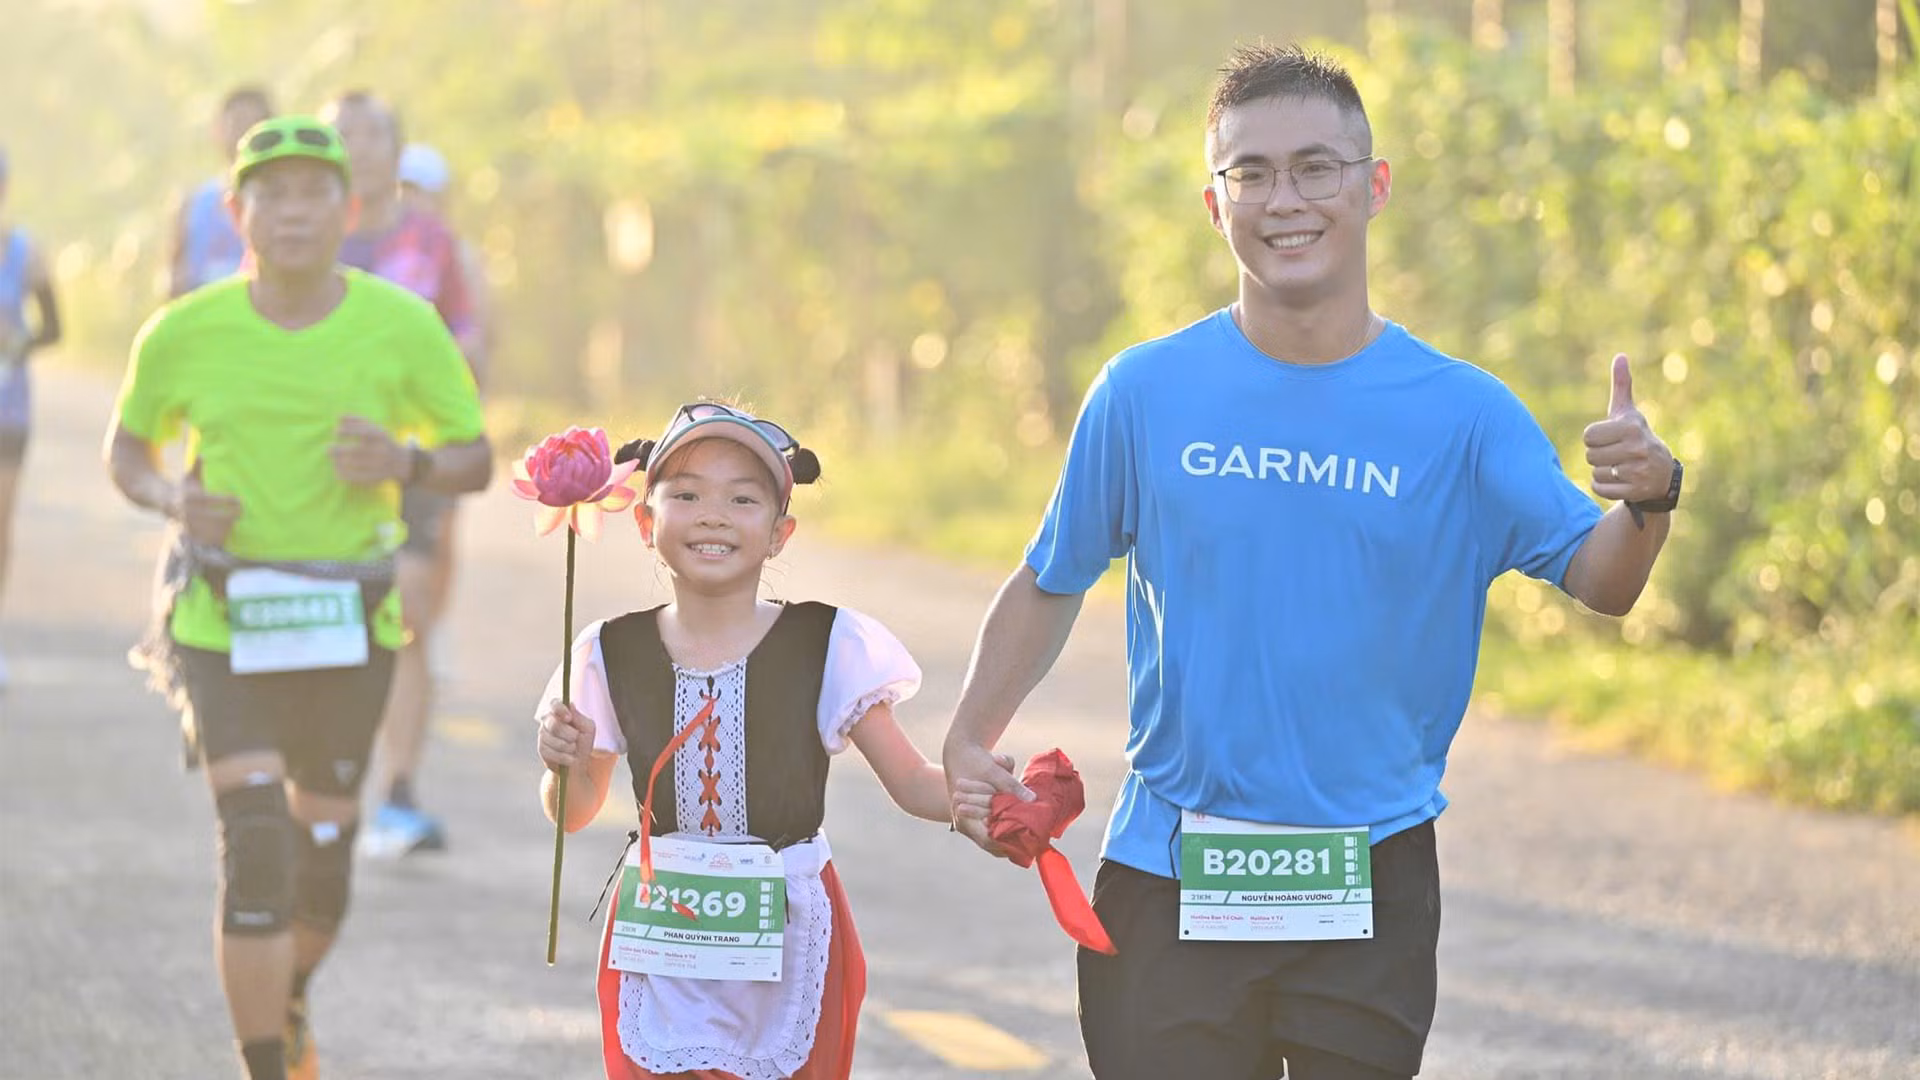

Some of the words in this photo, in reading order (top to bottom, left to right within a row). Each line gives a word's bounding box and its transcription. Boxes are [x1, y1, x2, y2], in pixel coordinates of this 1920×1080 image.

[1181, 441, 1400, 498] GARMIN
[1203, 848, 1330, 876] B20281
[664, 931, 684, 940] PHAN
